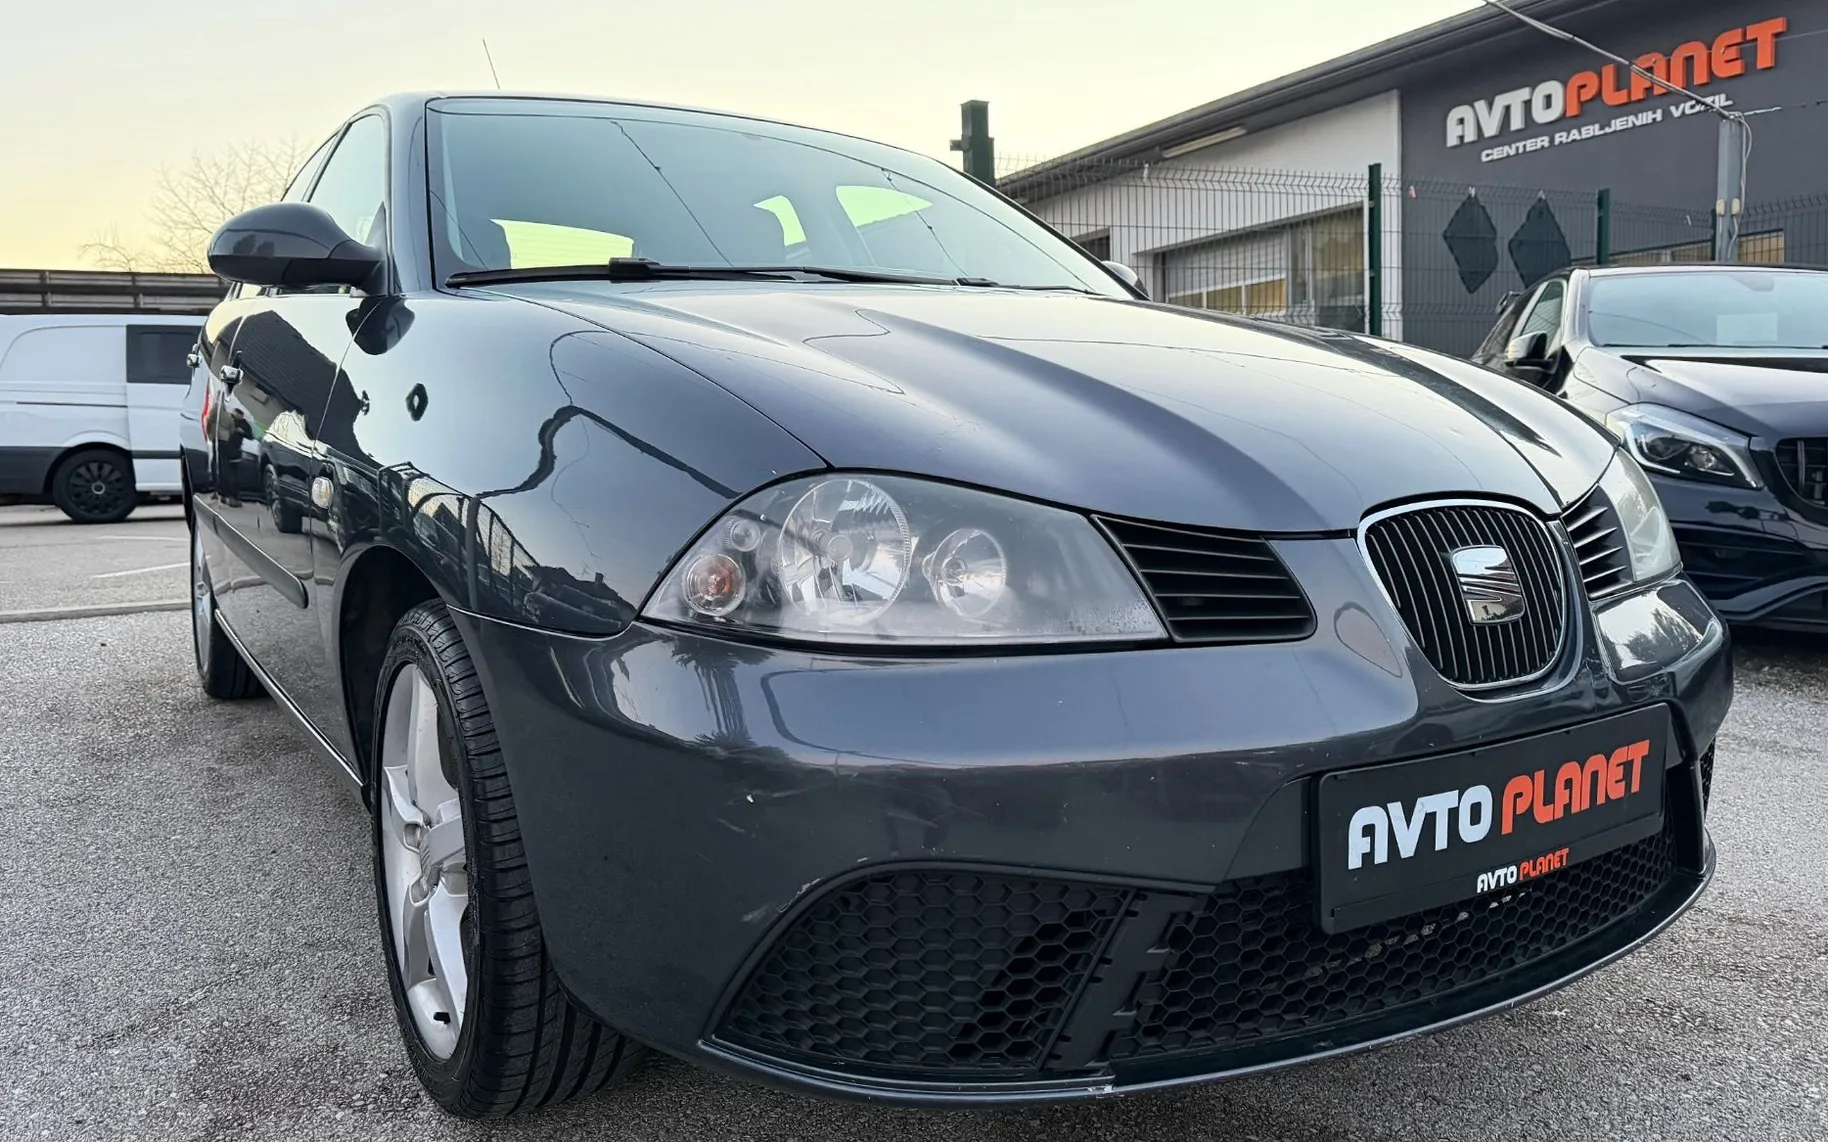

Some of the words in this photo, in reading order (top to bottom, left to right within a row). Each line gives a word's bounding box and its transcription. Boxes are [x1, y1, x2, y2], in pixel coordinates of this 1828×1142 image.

[1481, 136, 1549, 162] CENTER
[1554, 109, 1662, 145] RABLJENIH
[1348, 784, 1493, 870] AVTO
[1501, 739, 1649, 835] PLANET
[1477, 865, 1517, 893] AVTO
[1519, 847, 1569, 881] PLANET
